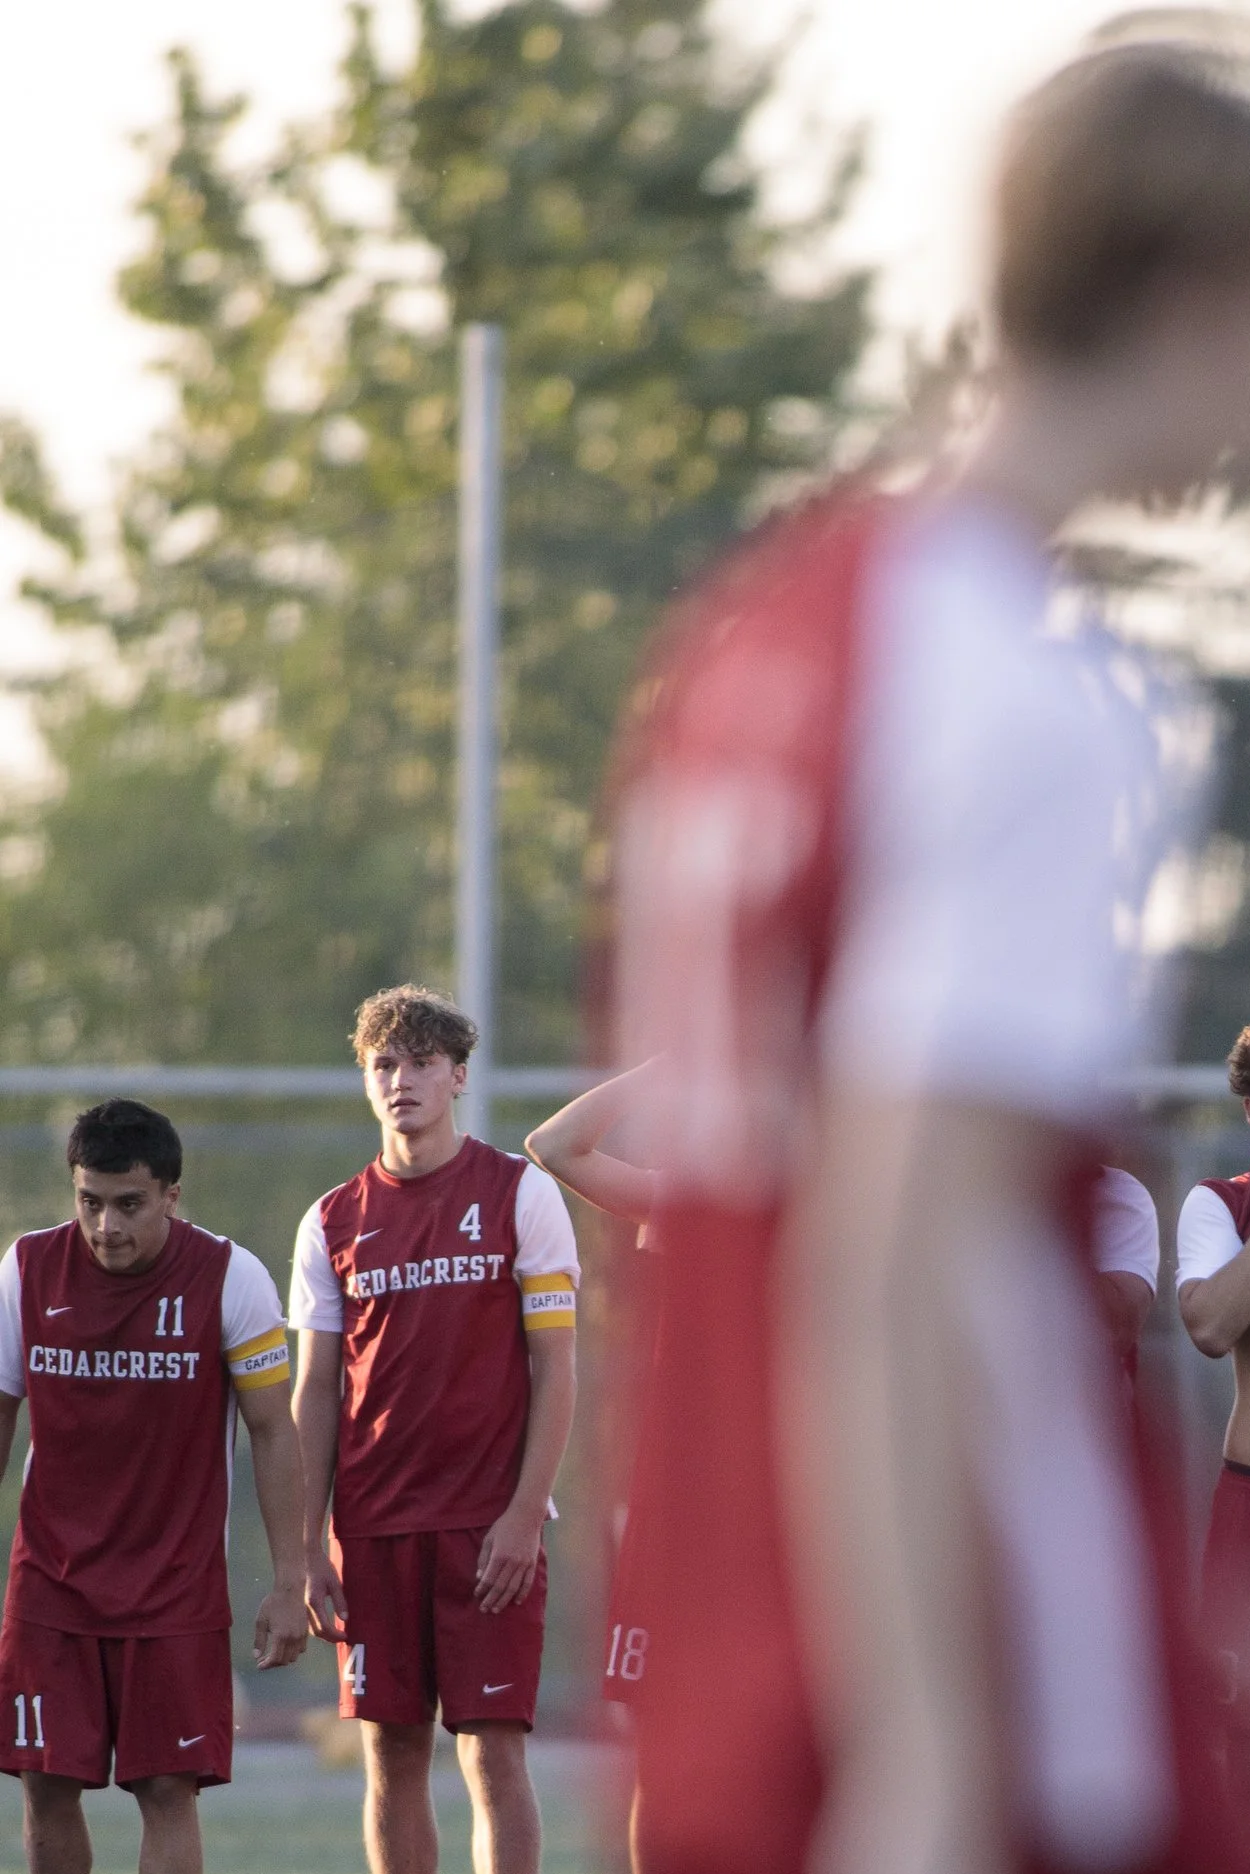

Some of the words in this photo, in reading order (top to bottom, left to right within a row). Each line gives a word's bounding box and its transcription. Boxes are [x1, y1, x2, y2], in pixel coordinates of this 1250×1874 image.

[459, 1203, 482, 1241] 4
[155, 1295, 185, 1337] 11
[531, 1294, 573, 1309] CAPTAIN
[29, 1345, 200, 1380] CEDARCREST
[343, 1643, 367, 1695] 4
[606, 1623, 650, 1681] 18
[14, 1693, 45, 1748] 11
